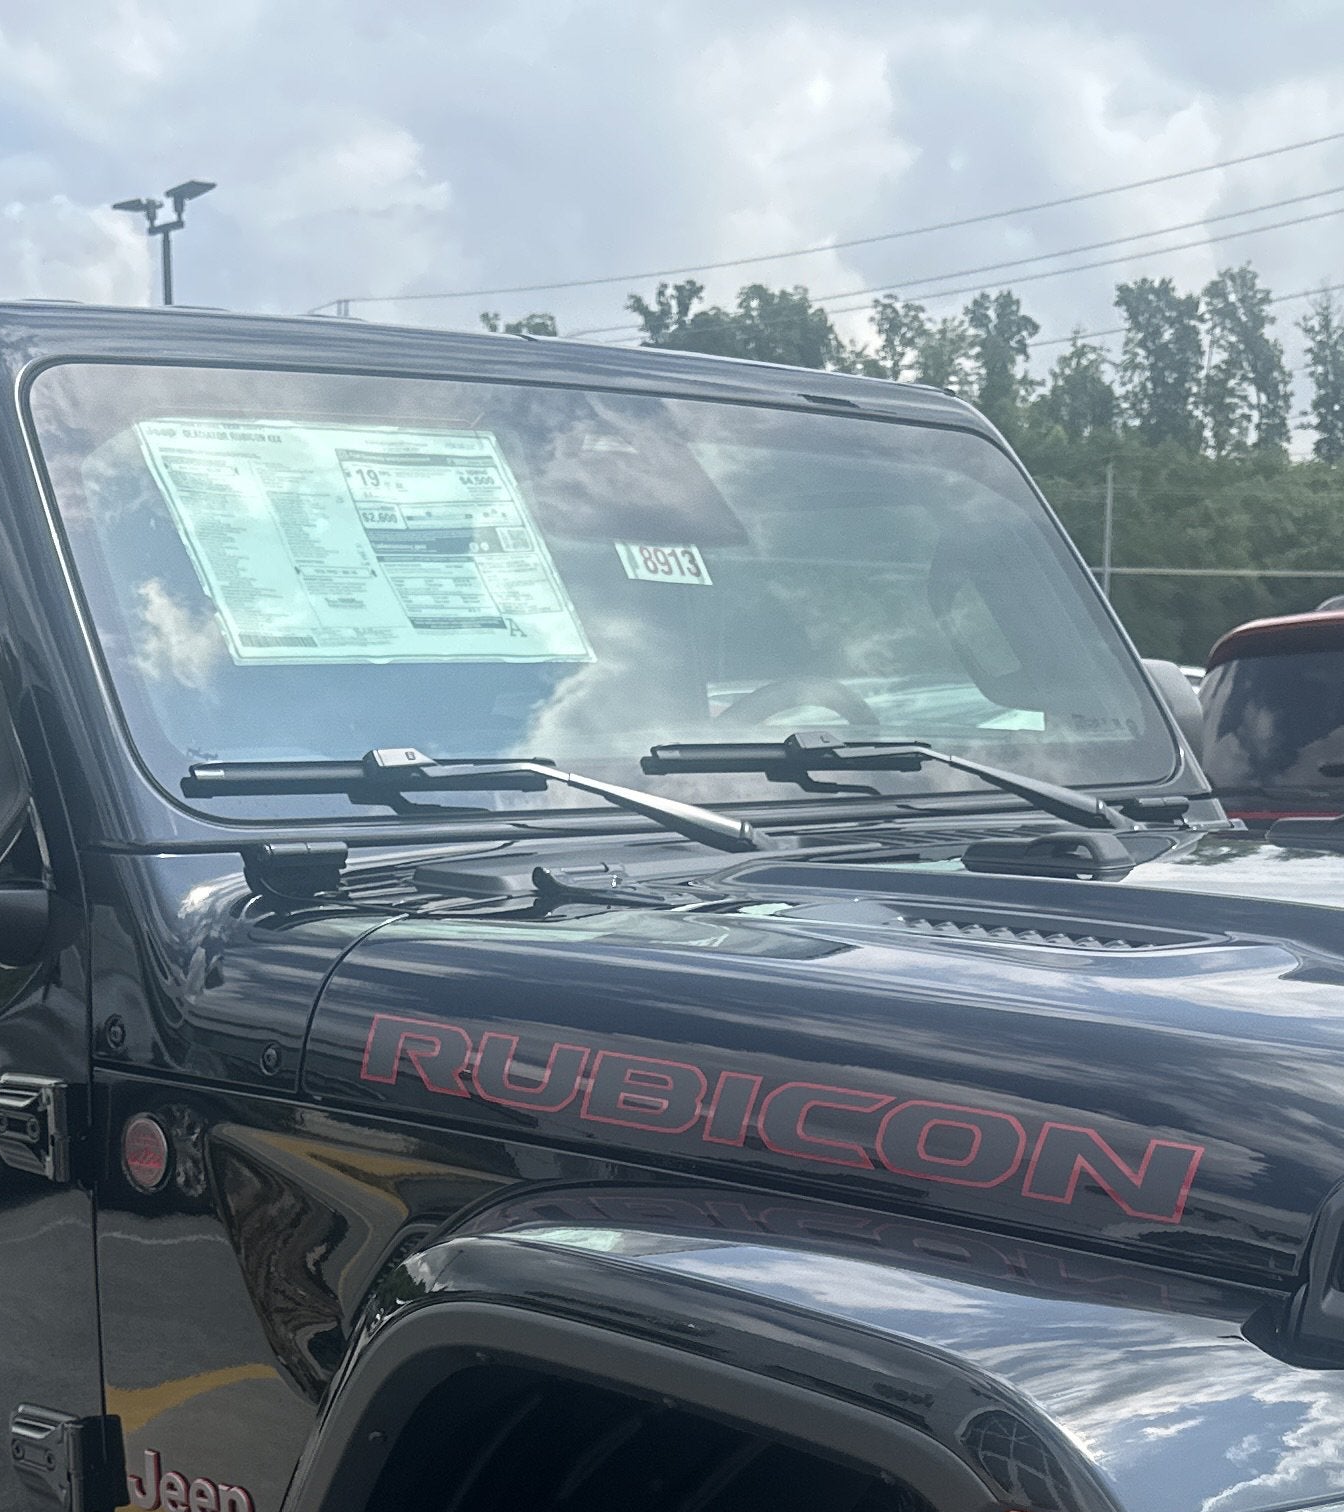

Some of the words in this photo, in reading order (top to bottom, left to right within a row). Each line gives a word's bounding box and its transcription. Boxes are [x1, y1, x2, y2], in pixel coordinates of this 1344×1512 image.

[356, 468, 380, 487] 19
[639, 545, 702, 578] 8913
[359, 1013, 1205, 1224] RUBICON
